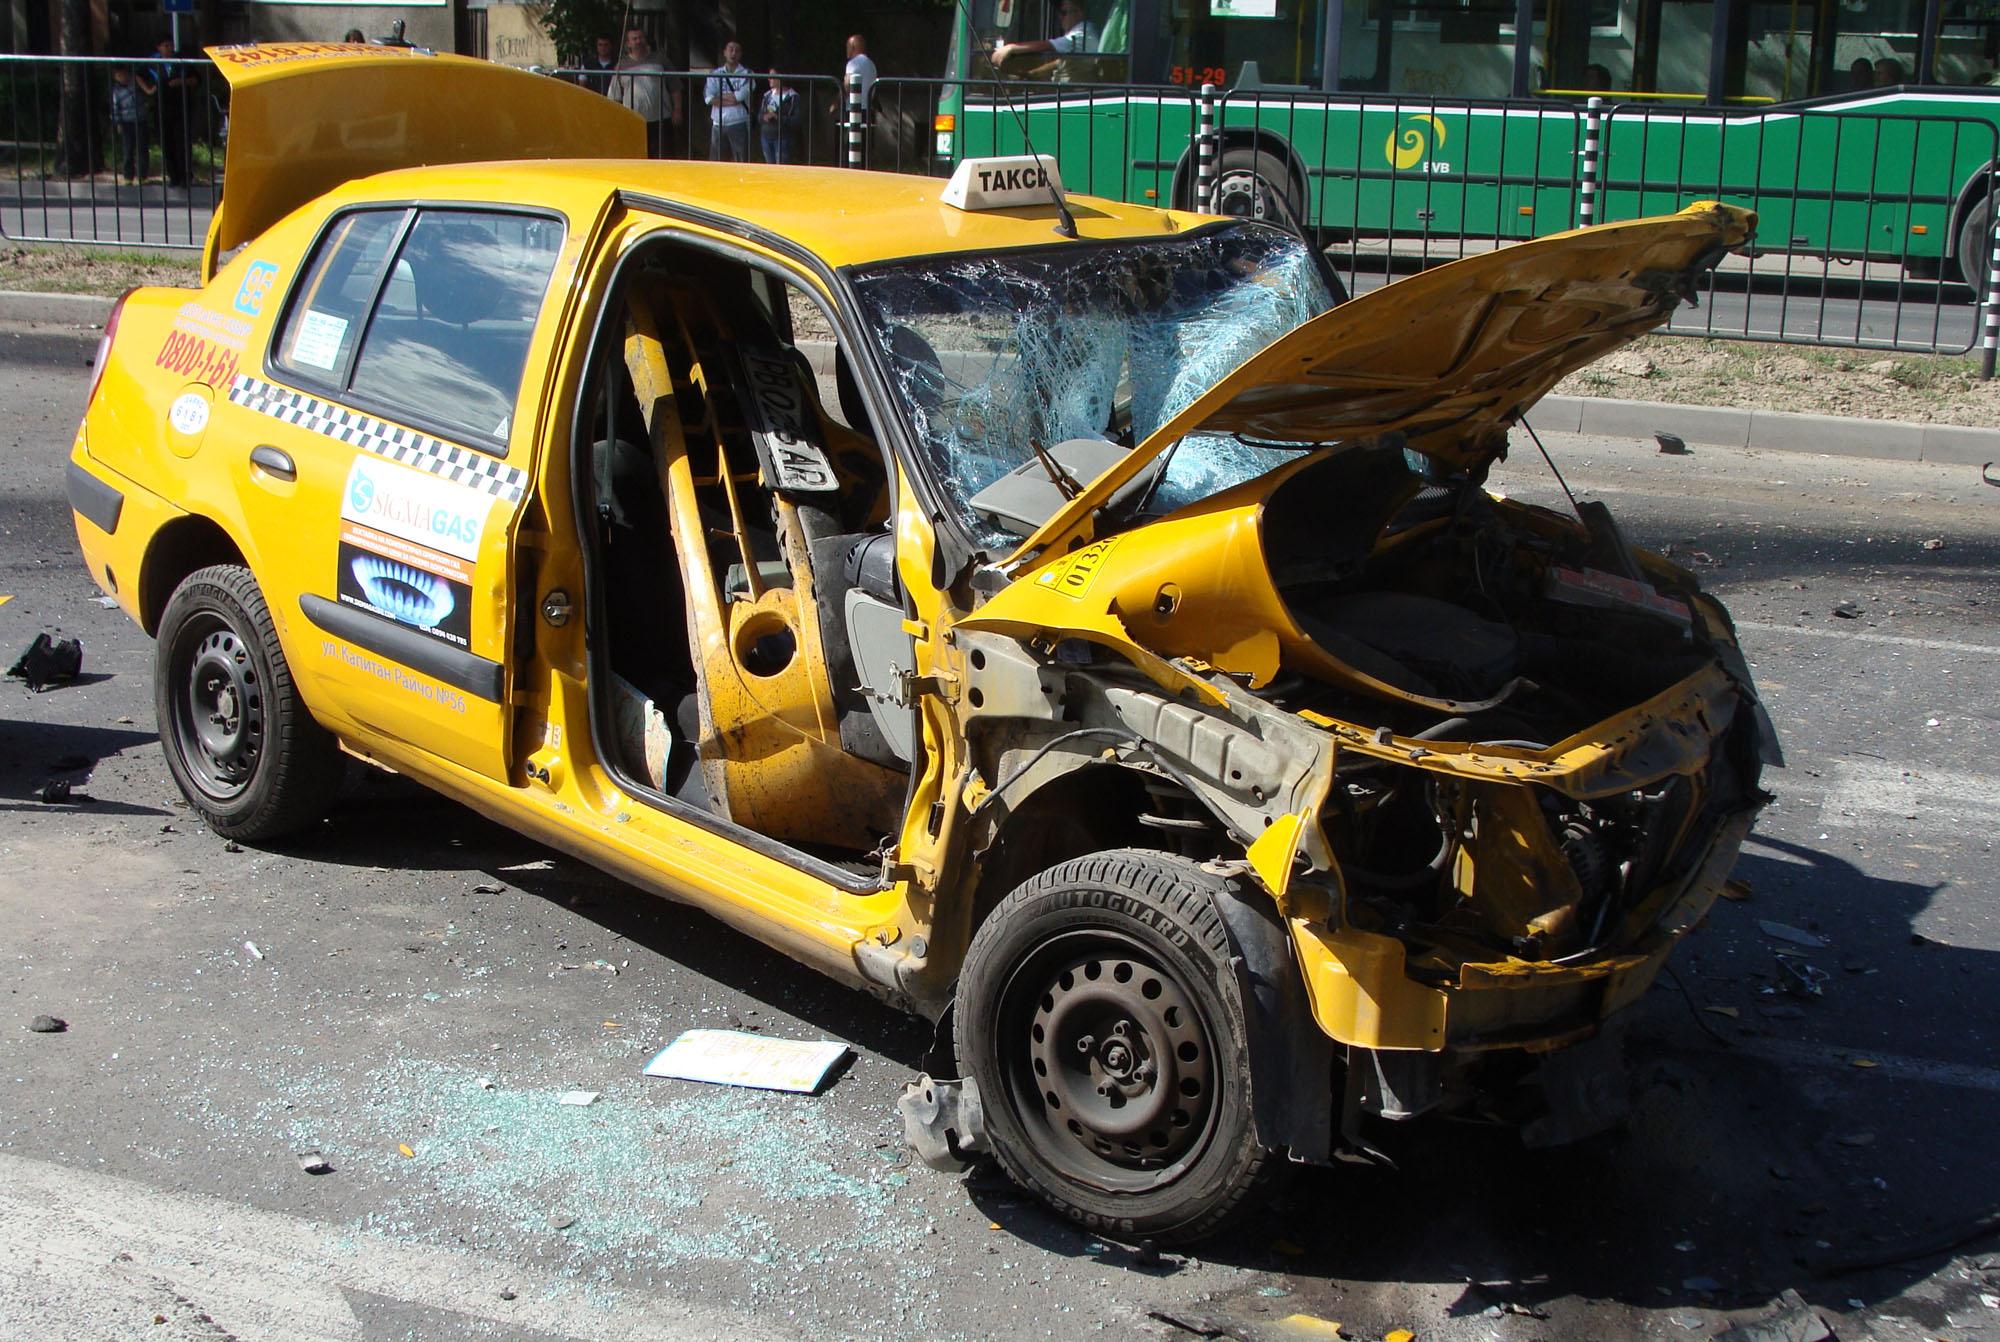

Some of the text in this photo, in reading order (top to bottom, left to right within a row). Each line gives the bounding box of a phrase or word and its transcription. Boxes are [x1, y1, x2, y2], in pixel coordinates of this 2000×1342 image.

[1171, 65, 1226, 85] 51-29
[341, 644, 392, 681] Капитан
[394, 668, 433, 699] Райчо
[1049, 891, 1190, 948] AUTOGUARD
